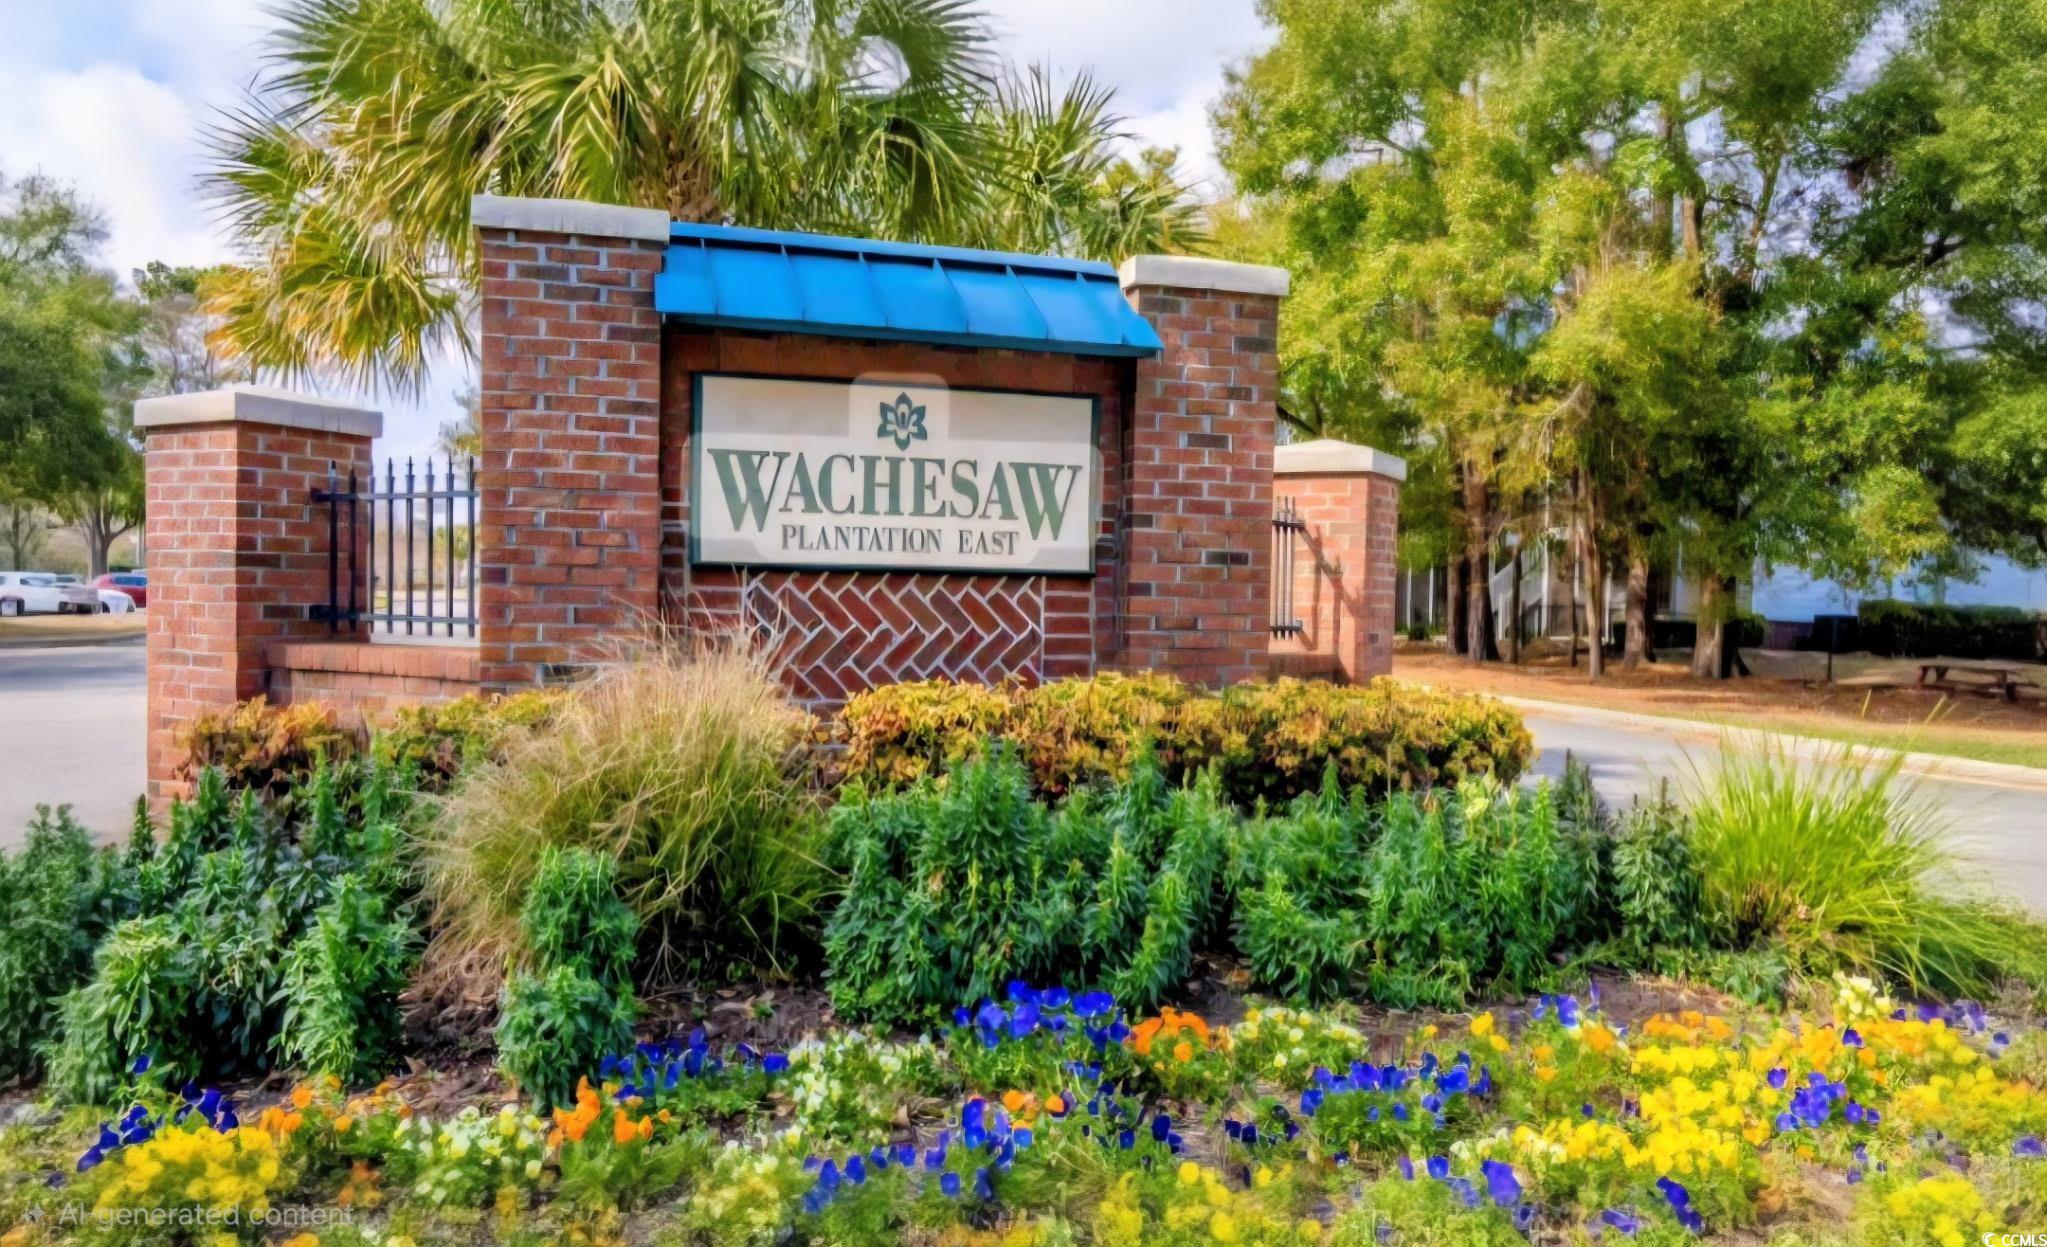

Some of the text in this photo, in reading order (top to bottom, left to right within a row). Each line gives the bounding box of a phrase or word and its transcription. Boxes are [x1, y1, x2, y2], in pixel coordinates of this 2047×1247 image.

[707, 448, 1083, 541] WACHESAW
[781, 523, 1019, 556] PLANTATION EAST
